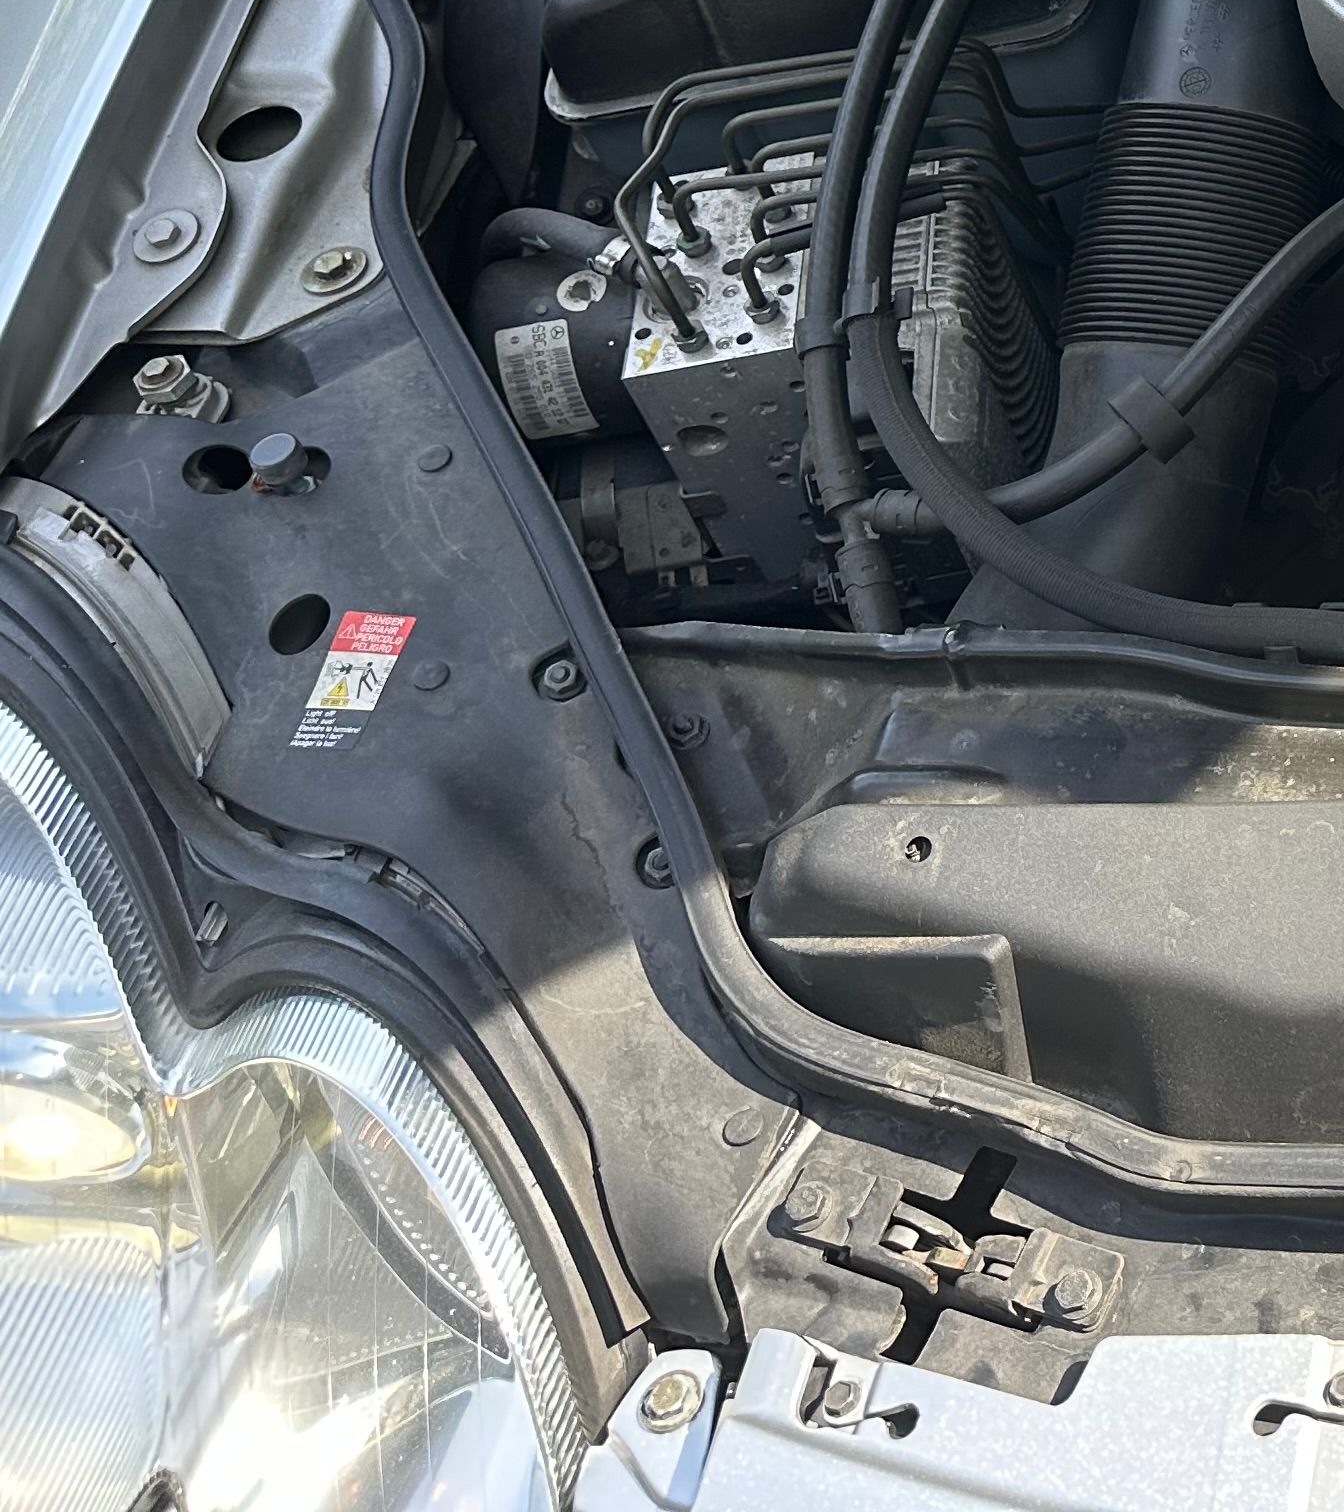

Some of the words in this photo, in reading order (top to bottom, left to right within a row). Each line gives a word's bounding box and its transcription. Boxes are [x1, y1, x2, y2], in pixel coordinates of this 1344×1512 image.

[531, 324, 548, 350] SBC
[535, 350, 545, 358] A
[363, 615, 405, 626] DANGER
[359, 625, 399, 635] GEFAHR
[355, 633, 404, 645] PERICOLO
[351, 642, 393, 653] PELIGRO
